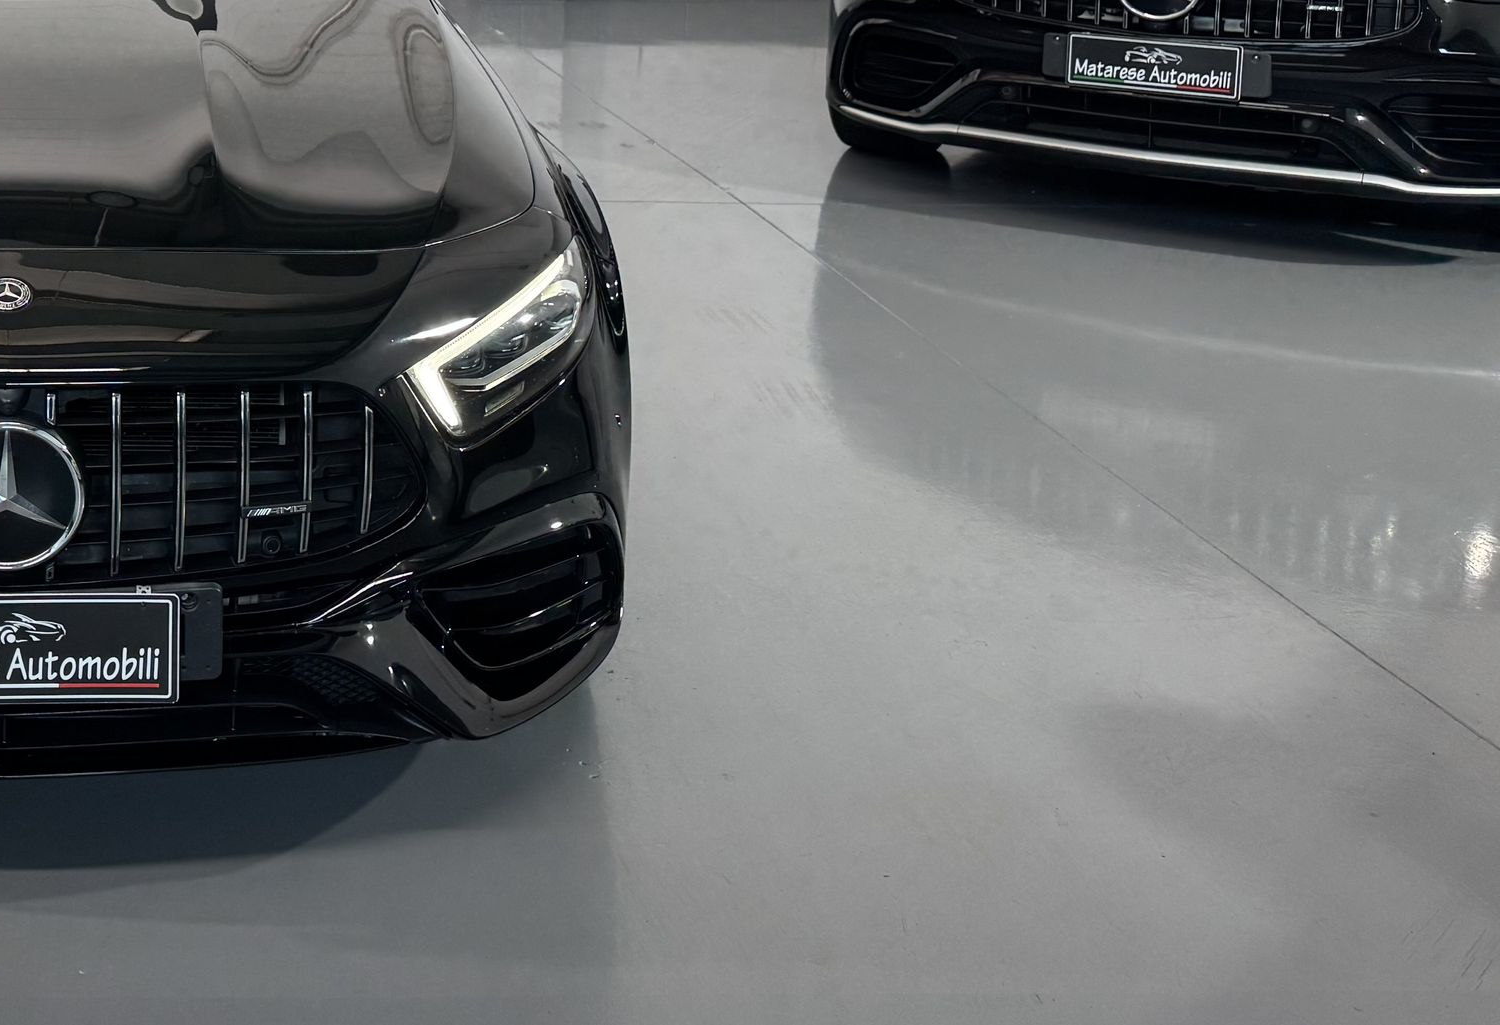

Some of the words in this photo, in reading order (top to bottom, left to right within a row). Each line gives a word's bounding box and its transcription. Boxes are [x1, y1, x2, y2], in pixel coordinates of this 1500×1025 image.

[1073, 58, 1146, 81] Matarese
[1149, 65, 1232, 89] Automobili
[5, 647, 160, 682] Automobili
